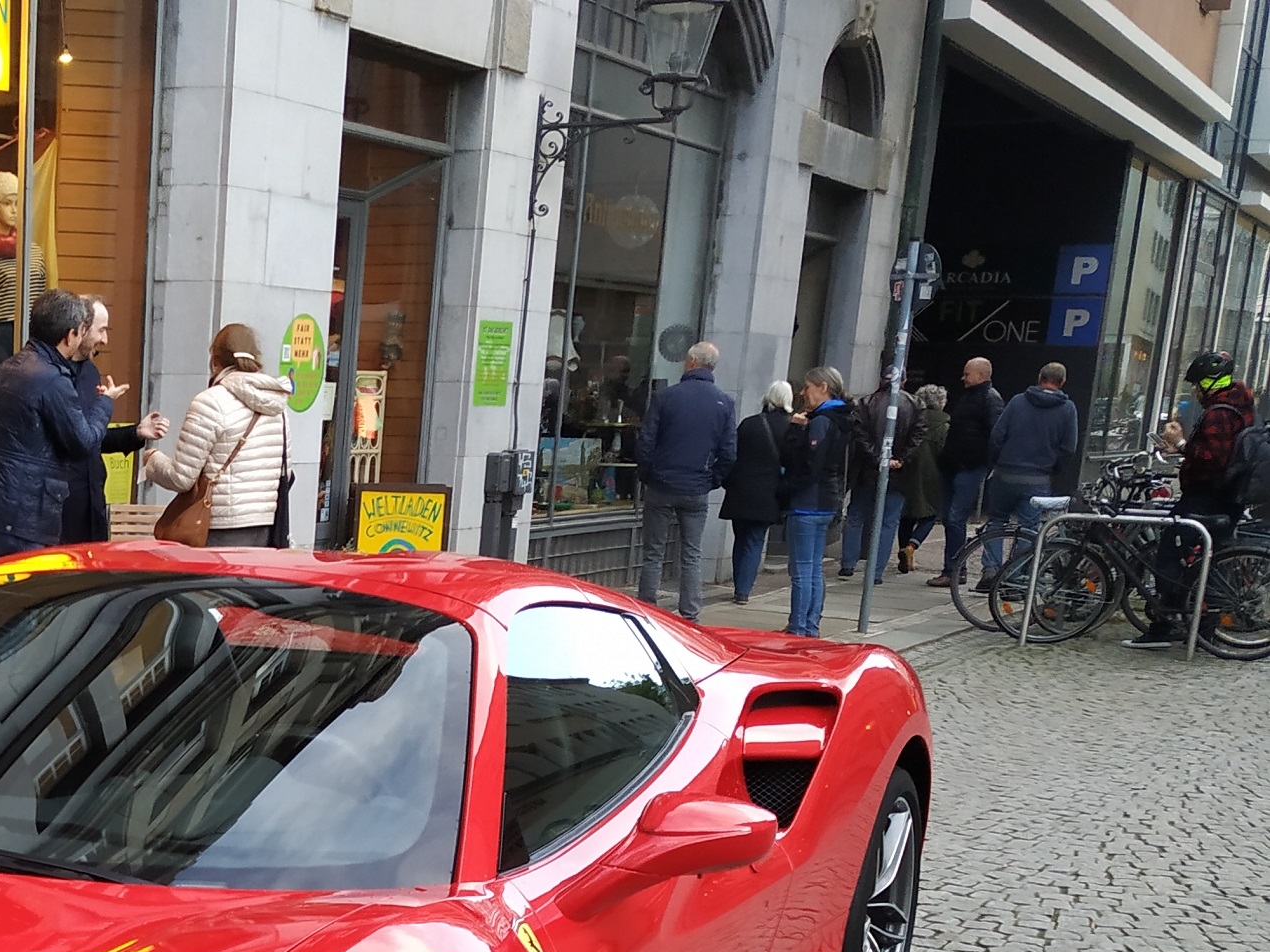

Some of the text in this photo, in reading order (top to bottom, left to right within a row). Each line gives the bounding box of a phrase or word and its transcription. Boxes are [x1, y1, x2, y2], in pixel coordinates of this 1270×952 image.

[939, 271, 1011, 290] RCADIA
[1071, 256, 1099, 285] P
[938, 300, 984, 322] FIT
[296, 323, 310, 333] FAIR
[983, 320, 1041, 343] ONE
[1063, 309, 1090, 336] P
[293, 337, 312, 346] STATT
[294, 349, 309, 358] MEHR
[362, 495, 442, 523] WELTLADEN
